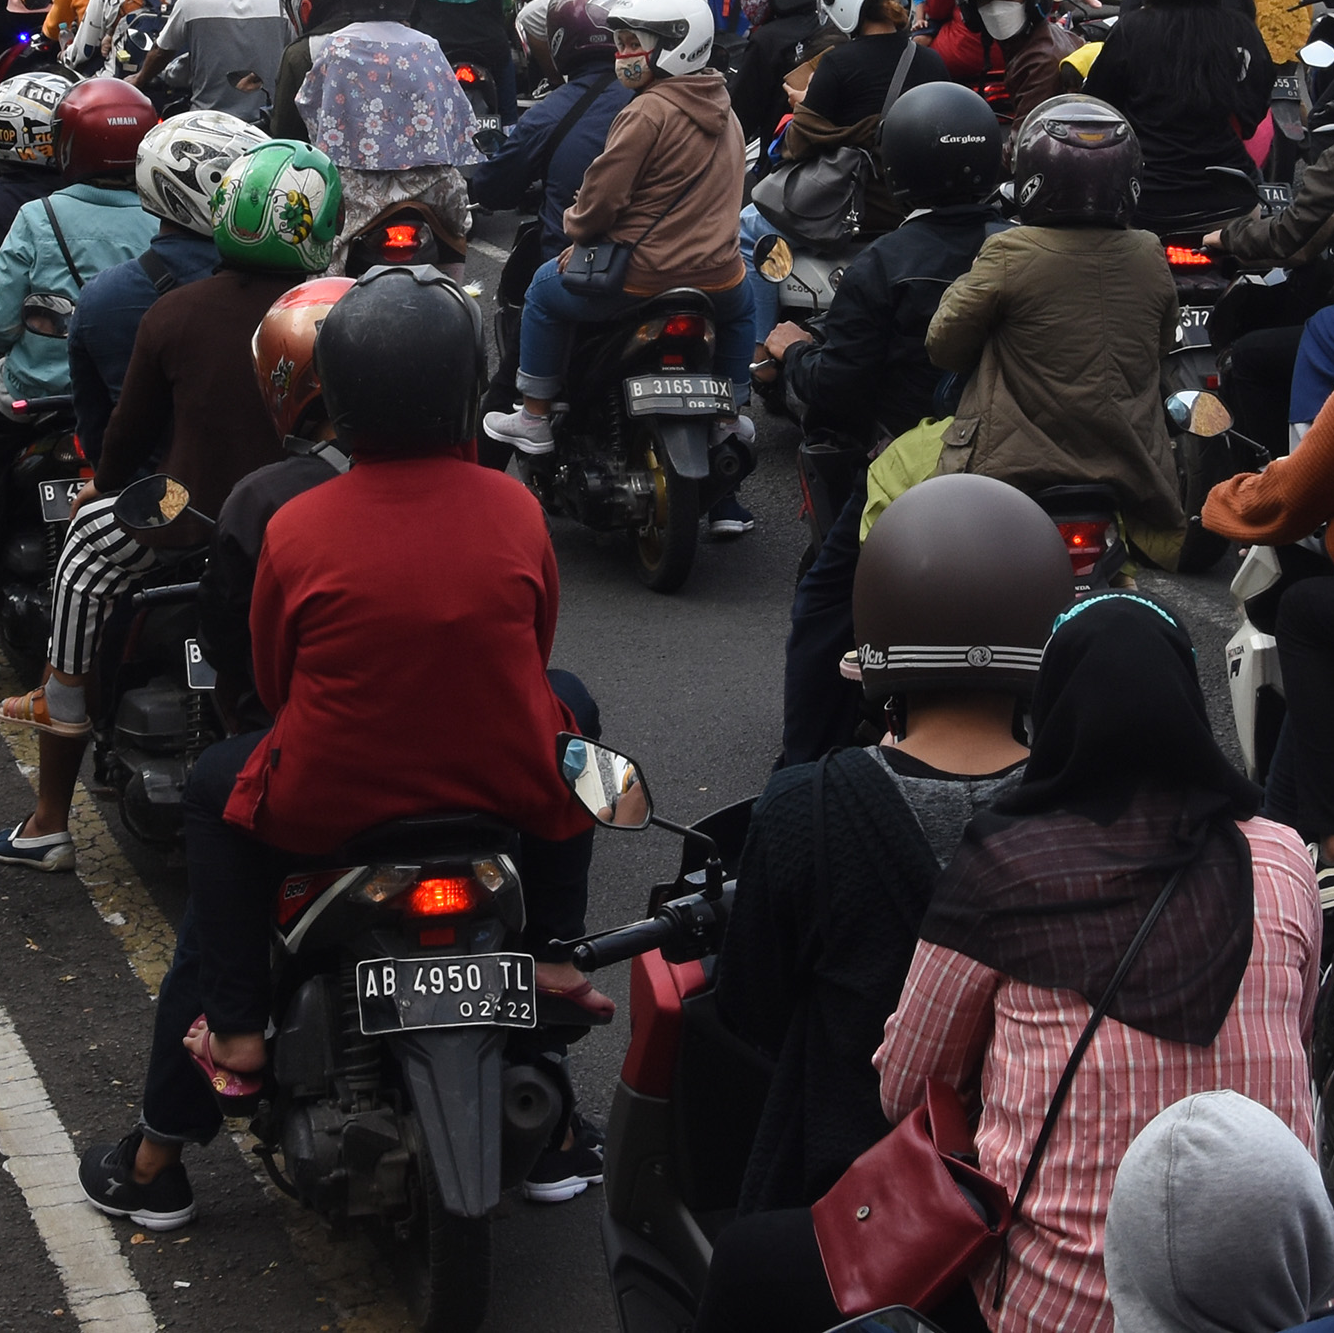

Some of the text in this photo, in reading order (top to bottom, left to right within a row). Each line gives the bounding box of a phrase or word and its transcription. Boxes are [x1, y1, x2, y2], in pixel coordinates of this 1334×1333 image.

[107, 117, 138, 126] YAMAHA
[940, 134, 986, 144] Cargloss
[1264, 189, 1288, 201] TAL
[787, 284, 823, 295] SCOOY
[633, 379, 730, 398] B 3165 TDX
[44, 484, 55, 501] B
[190, 644, 203, 663] B
[364, 961, 528, 998] AB 4950 TL
